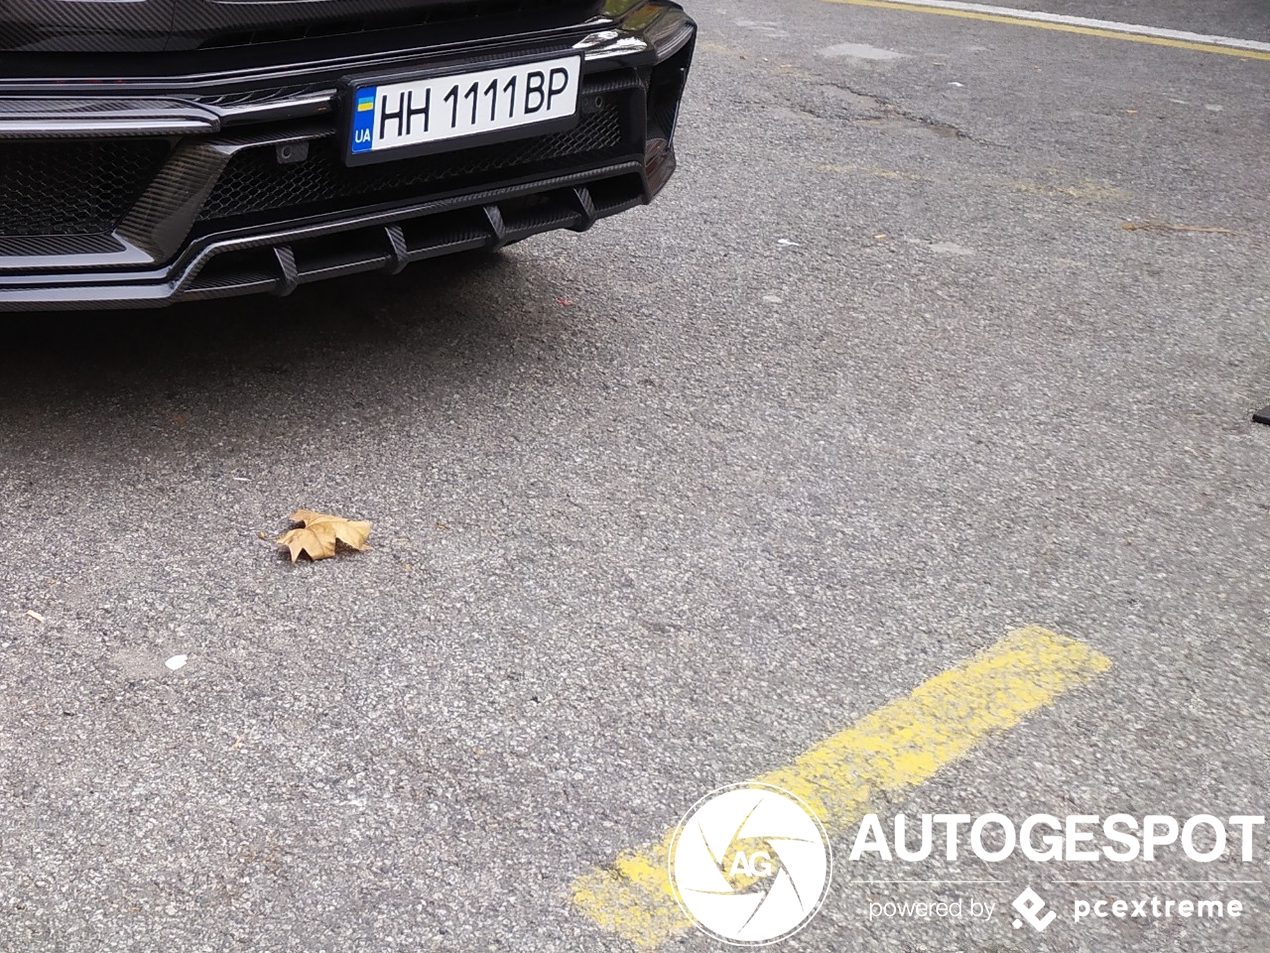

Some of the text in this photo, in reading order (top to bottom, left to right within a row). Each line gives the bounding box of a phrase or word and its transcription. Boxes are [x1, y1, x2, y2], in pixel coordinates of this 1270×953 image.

[380, 66, 569, 140] HH 1111 BP
[355, 128, 371, 143] UA
